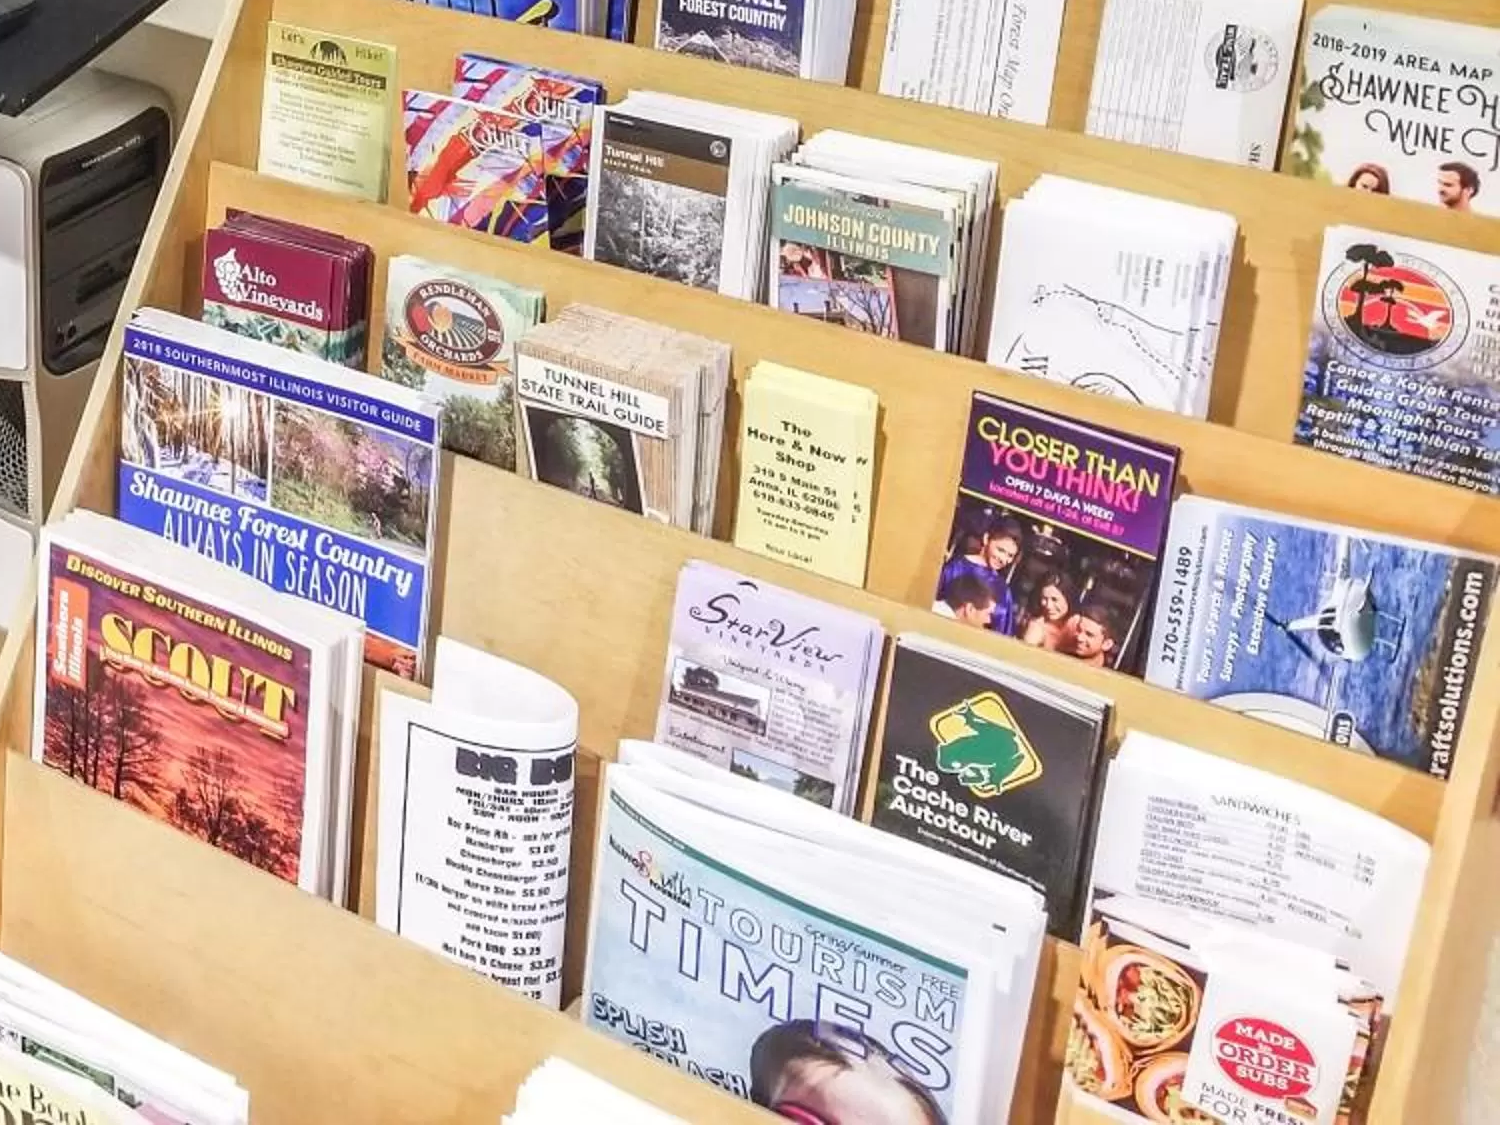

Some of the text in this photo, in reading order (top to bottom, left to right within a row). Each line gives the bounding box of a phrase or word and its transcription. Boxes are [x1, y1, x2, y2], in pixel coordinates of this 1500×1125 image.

[728, 4, 787, 31] COUNTRY
[1312, 32, 1493, 81] 2018-2019 AREA MAP
[1319, 61, 1455, 114] SHAWNEE
[1365, 108, 1455, 156] WINE
[783, 204, 865, 241] JOHNSON
[868, 223, 941, 256] COUNTY
[826, 234, 890, 260] ILLINOIS
[240, 263, 277, 286] Alto
[235, 281, 325, 322] Vineyards
[420, 334, 483, 363] ORCHARDS
[133, 338, 422, 432] 2018 SOUTHERNMOST ILLINOIS VISITOR GUIDE
[521, 378, 665, 433] STATE TRAIL GUIDE
[543, 367, 641, 409] TUNNEL HILL
[1336, 378, 1498, 428] Guided Group Tours
[1379, 373, 1393, 386] &
[1395, 376, 1448, 399] Kayak
[780, 420, 813, 438] The
[1306, 403, 1363, 426] Reptile
[1364, 418, 1378, 431] &
[1379, 421, 1471, 456] Amphibian
[1347, 397, 1480, 440] Moonlight Tours
[747, 426, 786, 446] Here
[791, 440, 803, 452] &
[809, 444, 847, 464] Now
[775, 450, 816, 473] Shop
[977, 416, 1161, 497] CLOSER THAN
[787, 487, 798, 498] IL
[791, 476, 820, 492] Main
[990, 442, 1142, 514] YOU THINK!
[1005, 475, 1035, 495] OPEN
[1035, 484, 1042, 497] 7
[1043, 488, 1071, 507] DAYS
[1071, 498, 1081, 511] A
[130, 472, 413, 597] Shawnee Forest Country
[163, 509, 367, 618] ALWAYS IN SEASON
[66, 555, 294, 661] DISCOVER SOUTHERN ILLINOIS
[1162, 546, 1193, 664] 270-559-1489
[1220, 530, 1259, 682] Surveys Photography
[1247, 536, 1279, 656] Executive Charter
[53, 589, 70, 676] Southern
[67, 617, 84, 682] Illinois
[100, 610, 296, 740] SCOUT
[1429, 571, 1484, 779] raftsolutions.com
[896, 755, 940, 785] The
[888, 796, 998, 851] Autotour
[892, 775, 1033, 847] Cache River
[620, 878, 951, 1092] TIMES
[697, 888, 958, 1031] TOURISM
[802, 924, 960, 998] Spring/Summer FREE
[592, 992, 688, 1054] SPLISH
[1235, 1023, 1296, 1050] MADE
[1219, 1042, 1311, 1082] ORDER
[1236, 1064, 1289, 1091] SUBS
[1199, 1093, 1247, 1125] FOR
[1201, 1082, 1249, 1107] MADE
